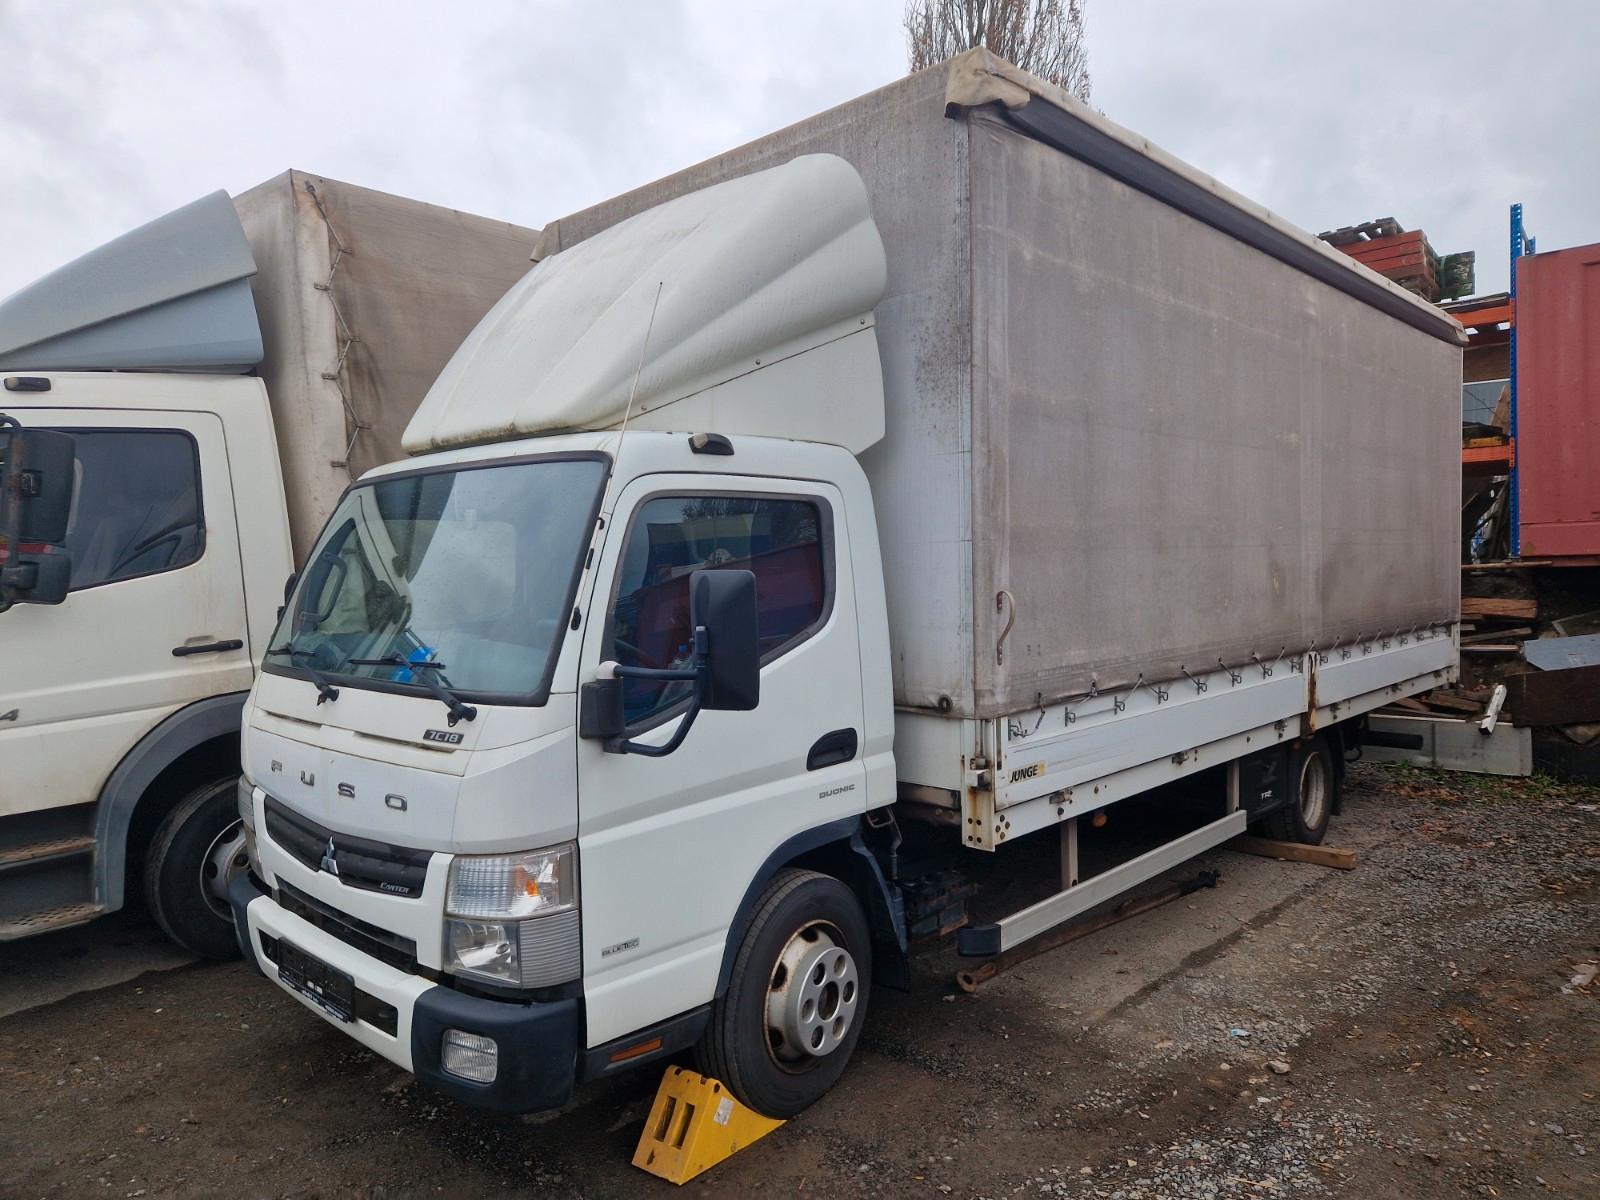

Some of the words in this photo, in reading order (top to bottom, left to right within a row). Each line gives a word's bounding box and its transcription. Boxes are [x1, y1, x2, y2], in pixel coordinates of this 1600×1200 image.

[429, 730, 459, 743] 7C18
[1009, 764, 1039, 783] JUNGE
[271, 759, 408, 812] FUSO
[819, 783, 856, 799] DUONIC
